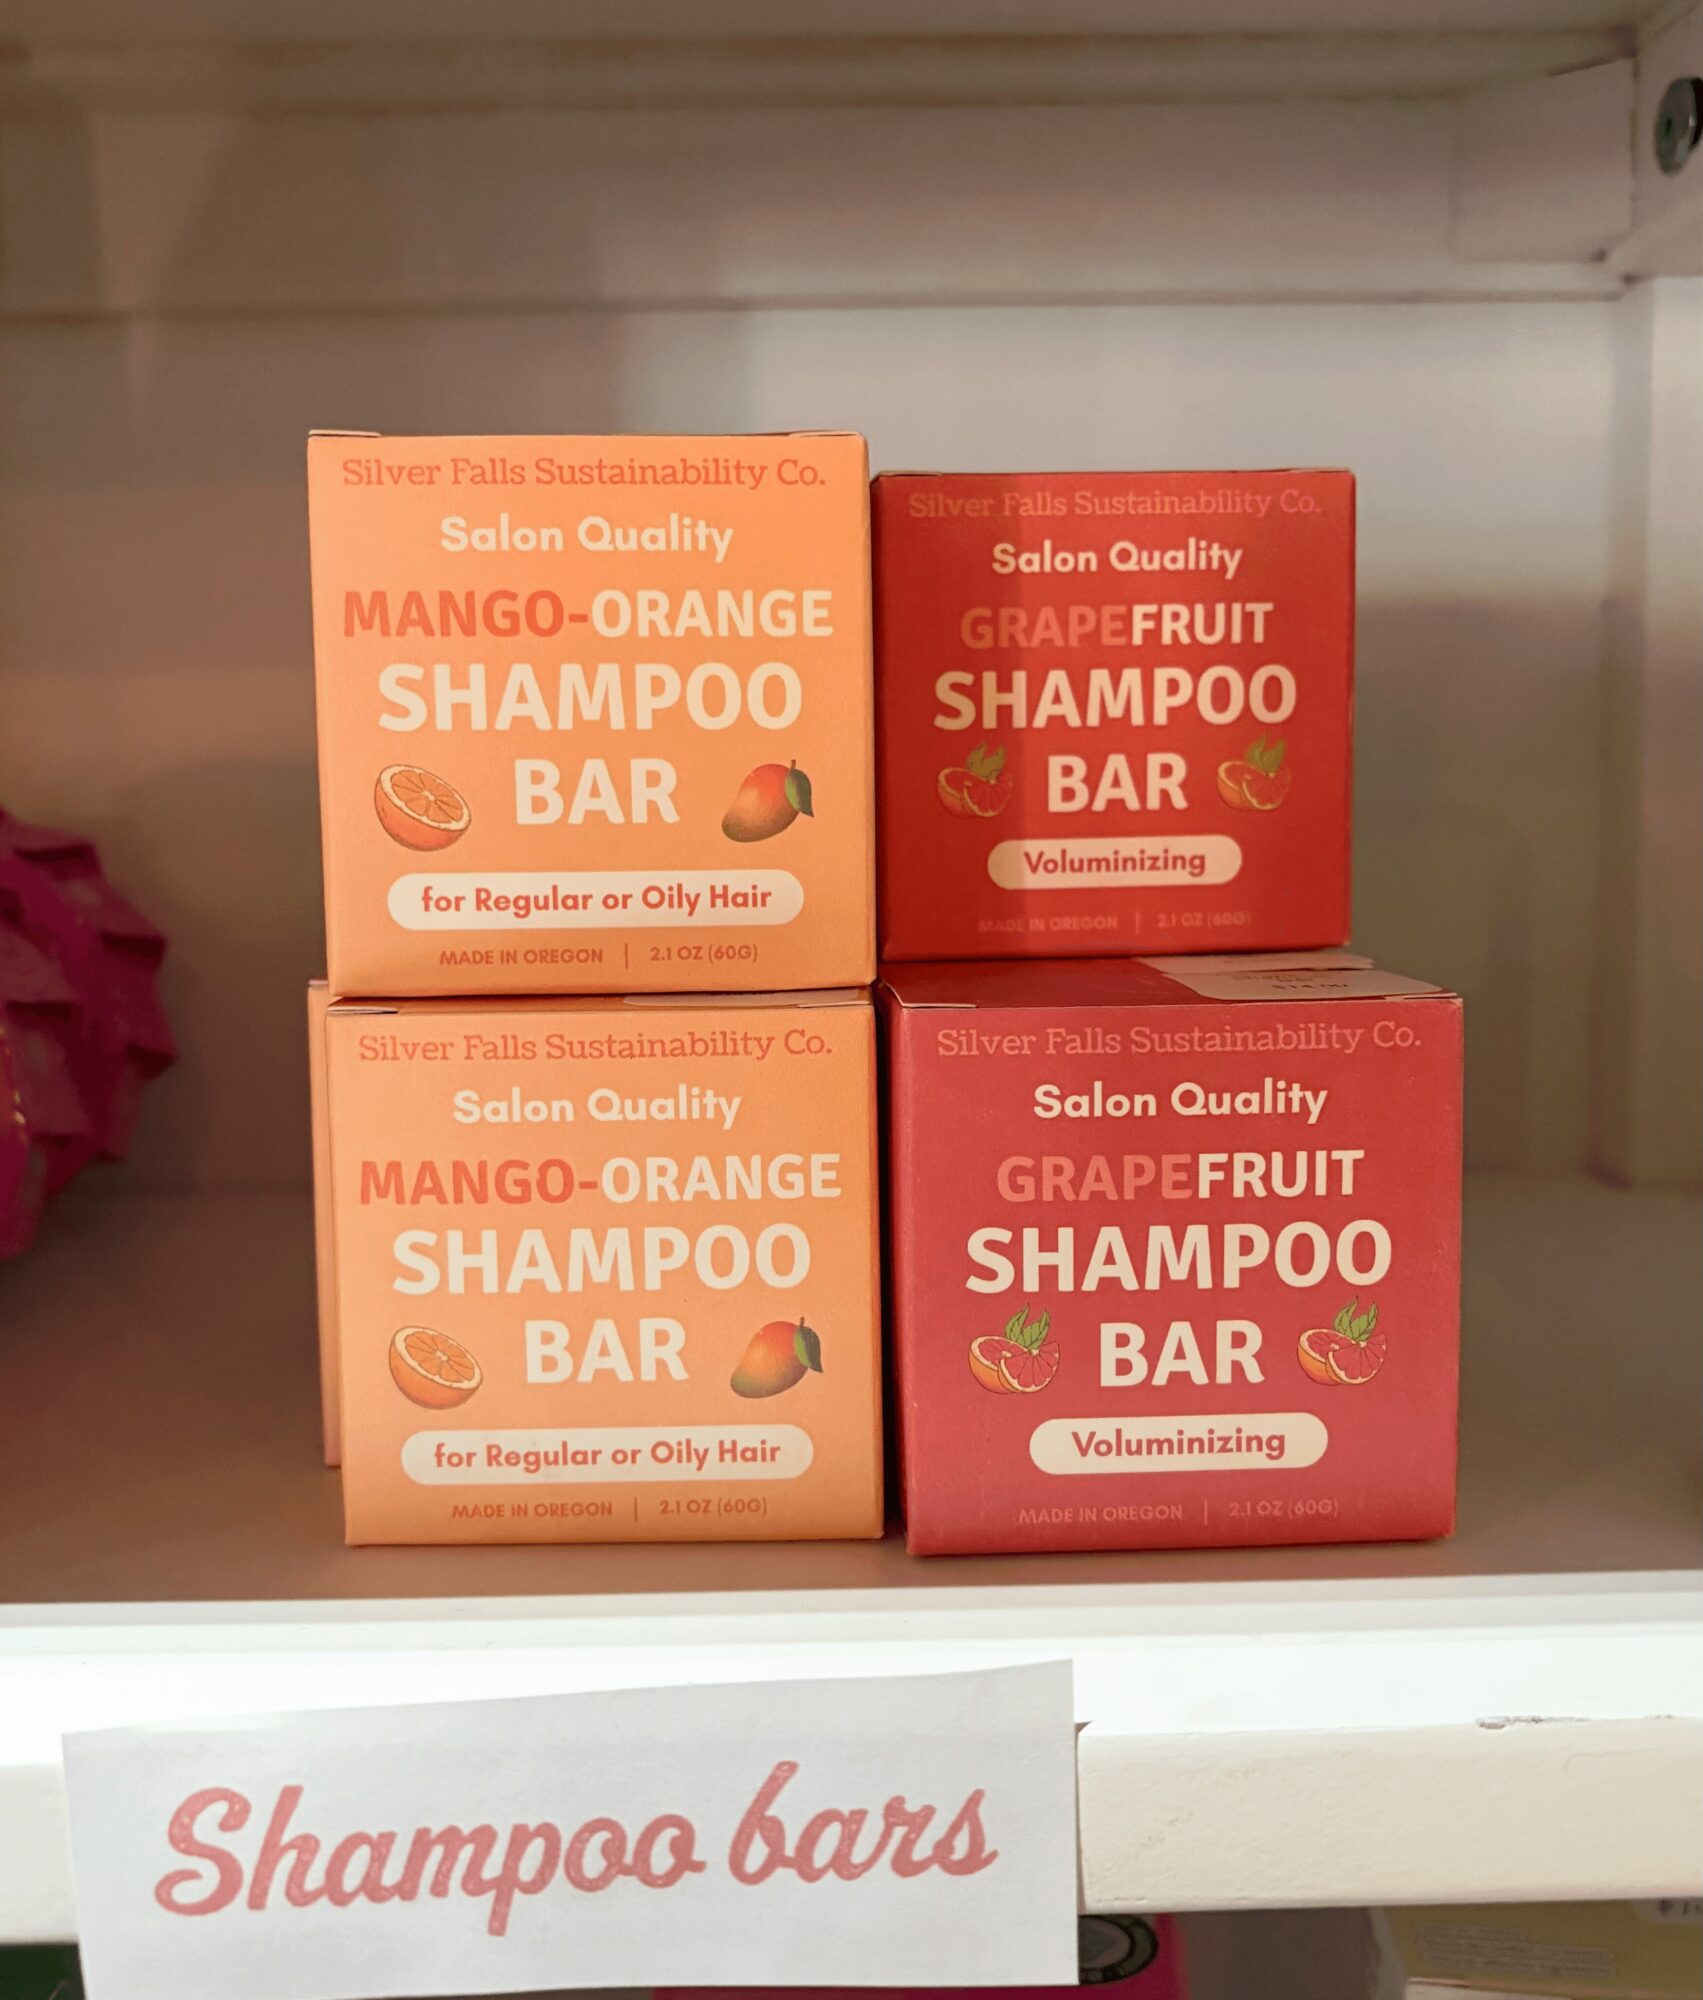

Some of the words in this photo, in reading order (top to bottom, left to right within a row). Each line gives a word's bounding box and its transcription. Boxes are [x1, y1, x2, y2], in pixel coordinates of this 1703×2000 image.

[342, 459, 440, 486] Silver
[452, 457, 525, 486] Falls
[535, 457, 768, 490] Sustainability
[777, 459, 826, 487] Co.
[909, 493, 992, 518] Silver
[1002, 493, 1067, 517] Falls
[1075, 490, 1270, 517] Sustainability
[1279, 491, 1321, 513] Co.
[440, 514, 563, 552] Salon
[577, 513, 734, 562] Quality
[992, 540, 1097, 574] Salon
[1109, 538, 1243, 580] Quality
[343, 589, 833, 637] MANGO-ORANGE
[960, 602, 1274, 649] GRAPEFRUIT
[378, 662, 802, 732] SHAMPOO
[934, 665, 1296, 730] SHAMPOO
[514, 758, 680, 825] BAR
[1047, 753, 1188, 812] BAR
[1023, 850, 1206, 877] Voluminizing
[421, 887, 465, 912] for
[475, 887, 593, 919] Regular
[602, 891, 632, 910] or
[642, 885, 700, 916] Oily
[709, 885, 772, 908] Hair
[440, 950, 494, 966] MADE
[500, 949, 518, 965] IN
[524, 948, 603, 965] OREGON
[650, 946, 673, 962] 2.1
[677, 946, 703, 961] OZ
[707, 944, 758, 962] (60G)
[359, 1034, 454, 1062] Silver
[464, 1033, 536, 1060] Falls
[546, 1030, 775, 1062] Sustainability
[784, 1030, 832, 1056] Co.
[937, 1028, 1035, 1057] Silver
[1046, 1027, 1121, 1055] Falls
[1131, 1022, 1364, 1055] Sustainability
[1373, 1021, 1422, 1049] Co.
[454, 1086, 574, 1124] Salon
[588, 1084, 742, 1130] Quality
[1033, 1080, 1157, 1119] Salon
[1171, 1077, 1328, 1125] Quality
[360, 1153, 841, 1206] MANGO-ORANGE
[997, 1149, 1365, 1203] GRAPEFRUIT
[392, 1223, 811, 1295] SHAMPOO
[965, 1219, 1391, 1294] SHAMPOO
[525, 1317, 689, 1383] BAR
[1100, 1320, 1265, 1388] BAR
[435, 1443, 475, 1468] for
[486, 1441, 601, 1474] Regular
[611, 1446, 641, 1465] or
[651, 1439, 709, 1471] Oily
[719, 1439, 780, 1463] Hair
[1072, 1429, 1286, 1460] Voluminizing
[452, 1504, 505, 1519] MADE
[512, 1504, 528, 1518] IN
[534, 1502, 613, 1518] OREGON
[659, 1500, 682, 1515] 2.1
[686, 1499, 711, 1514] OZ
[716, 1497, 767, 1516] (60G)
[1018, 1507, 1073, 1524] MADE
[1080, 1506, 1098, 1523] IN
[1103, 1504, 1183, 1522] OREGON
[1230, 1501, 1253, 1517] 2.1
[1257, 1500, 1283, 1517] OZ
[1288, 1498, 1339, 1518] (60G)
[154, 1785, 706, 1937] Shampoo
[728, 1760, 999, 1886] bars
